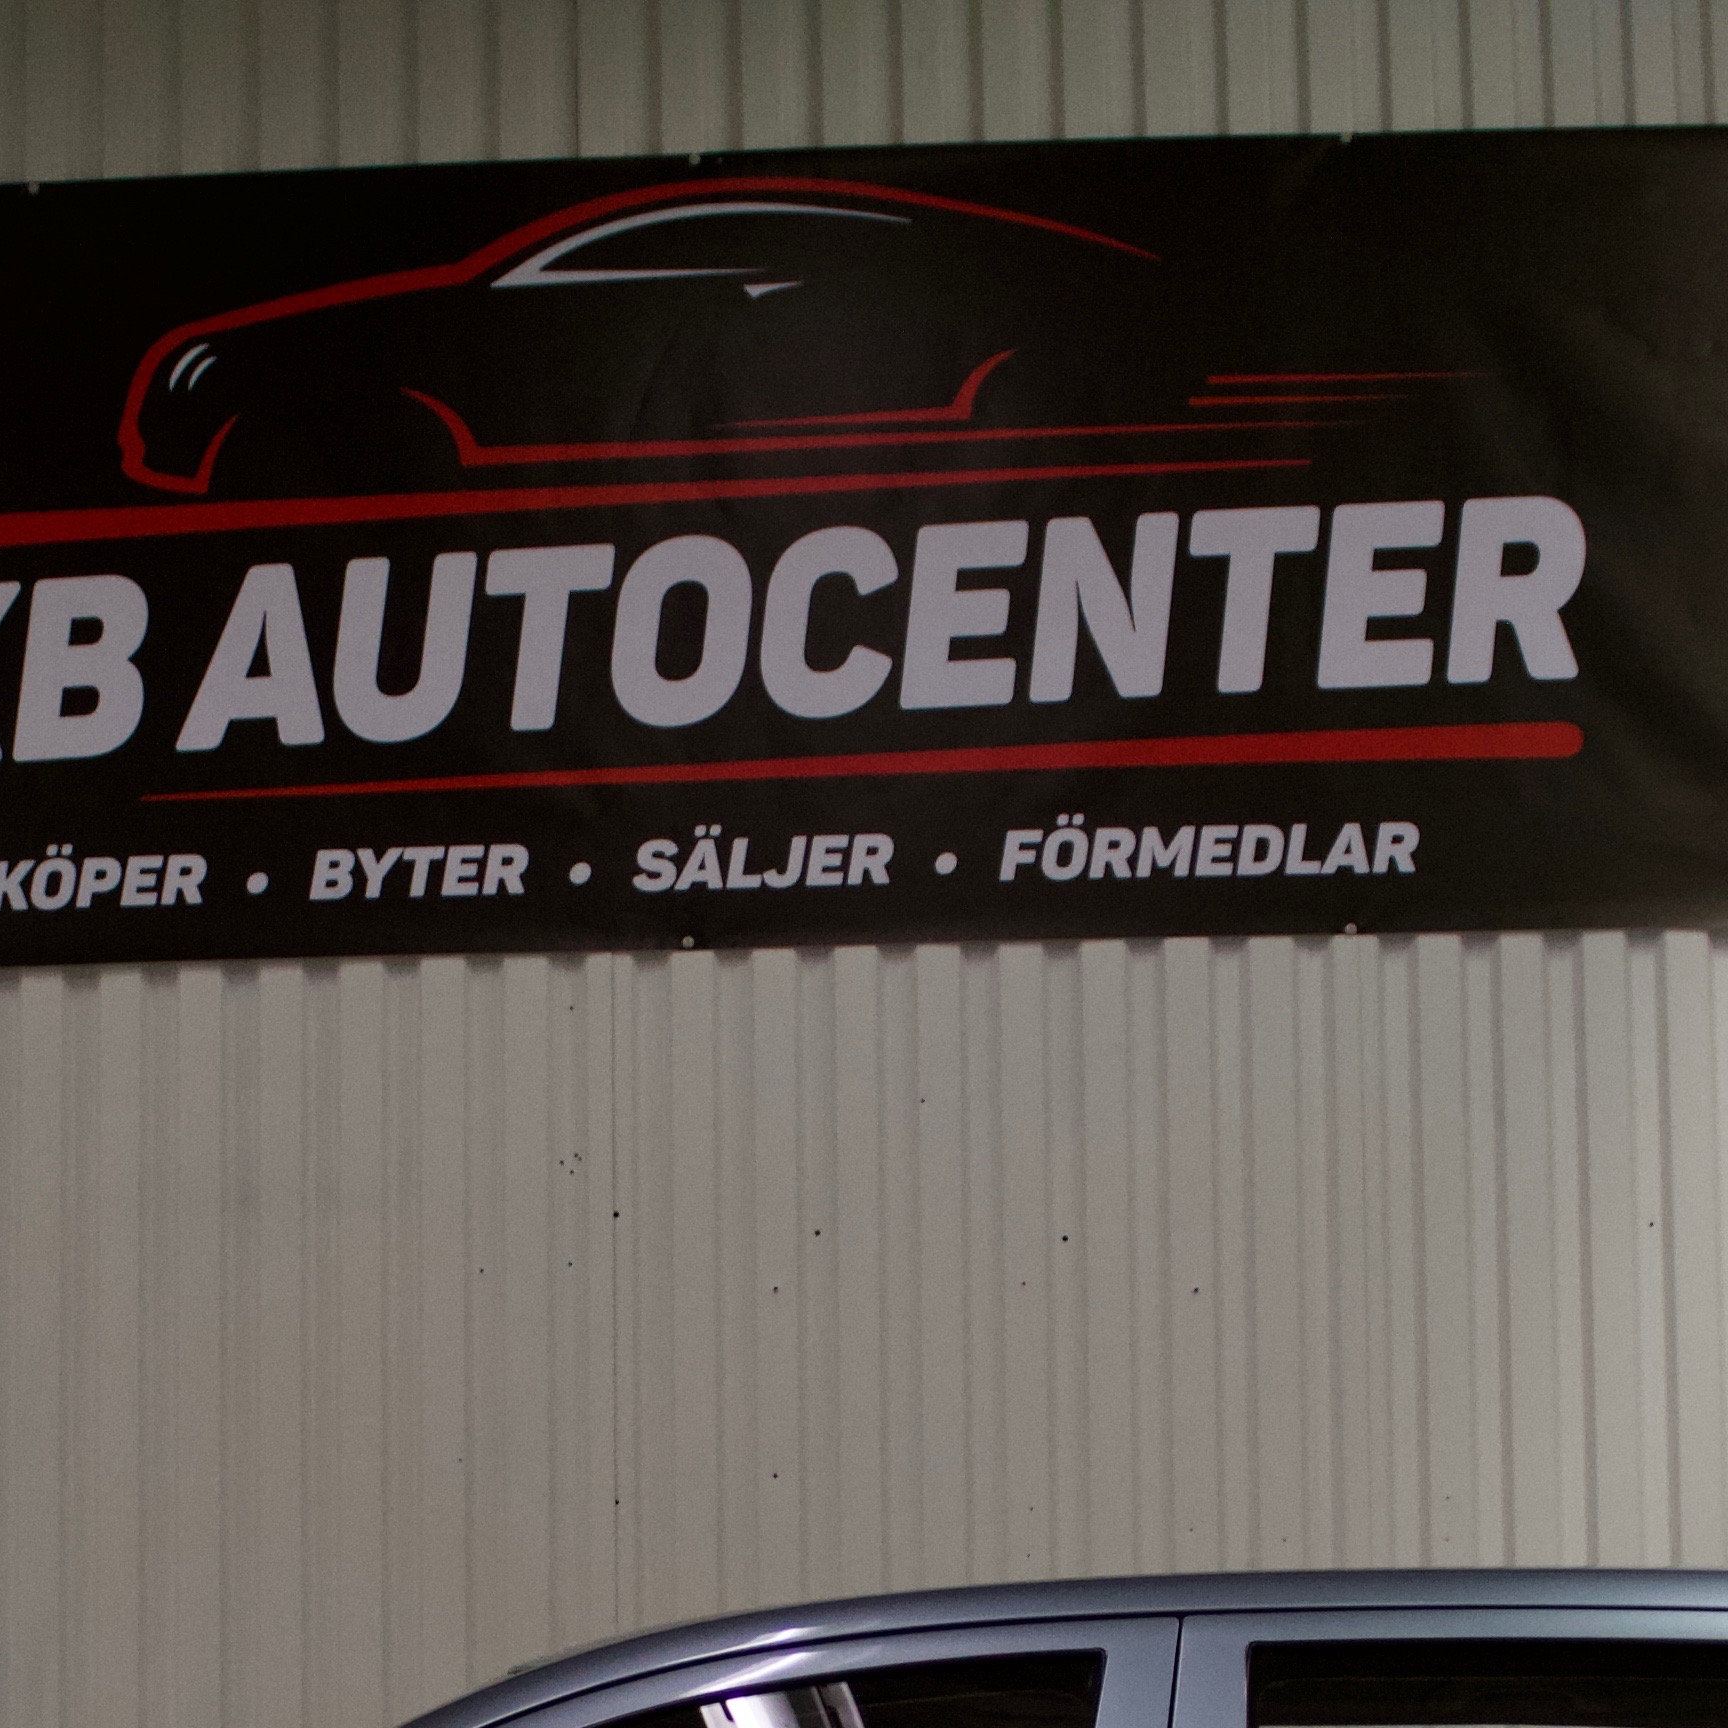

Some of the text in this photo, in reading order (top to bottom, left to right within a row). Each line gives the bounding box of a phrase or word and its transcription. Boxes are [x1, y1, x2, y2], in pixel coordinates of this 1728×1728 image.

[173, 494, 1588, 753] AUTOCENTER
[308, 843, 530, 901] BYTER
[631, 823, 896, 893] SÄLJER
[998, 812, 1421, 882] FÖRMEDLAR
